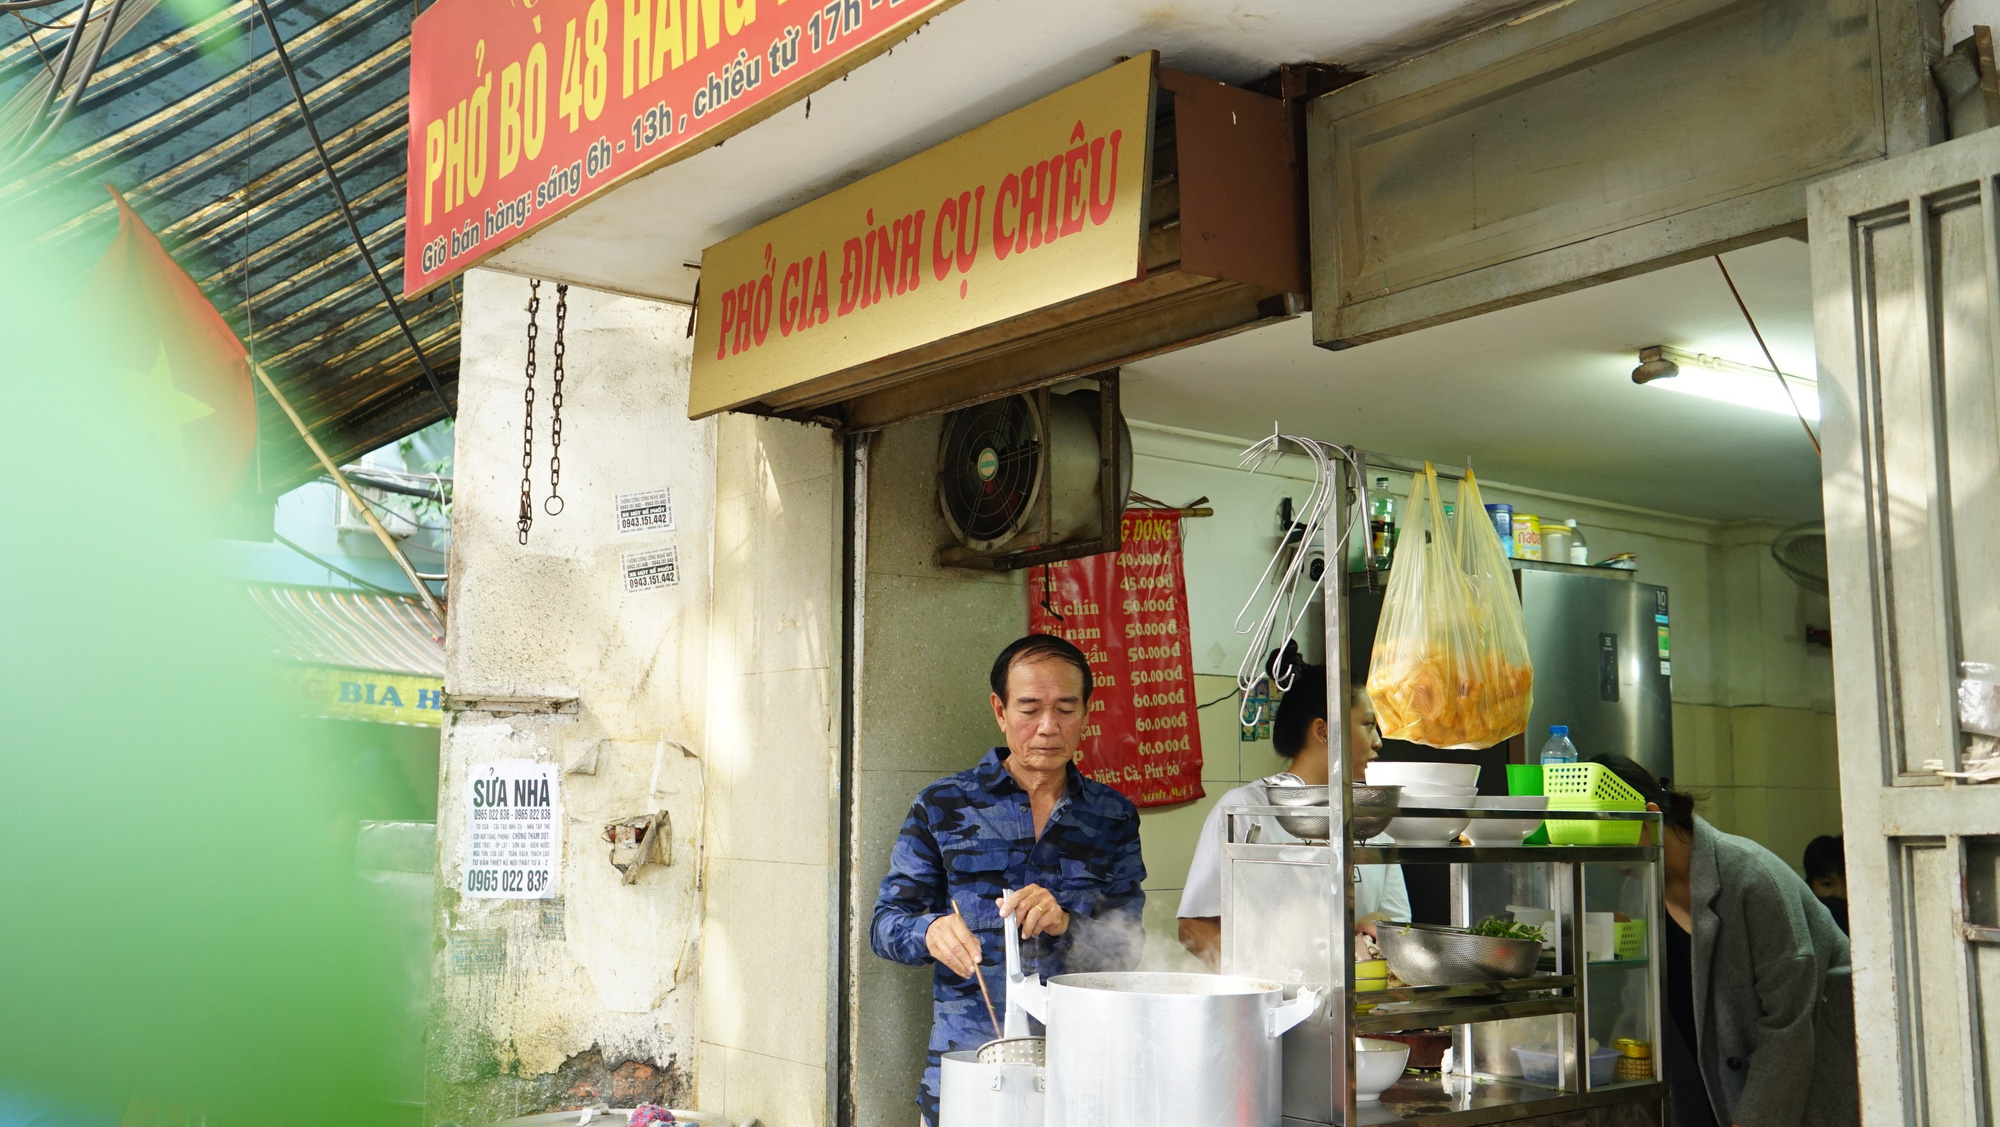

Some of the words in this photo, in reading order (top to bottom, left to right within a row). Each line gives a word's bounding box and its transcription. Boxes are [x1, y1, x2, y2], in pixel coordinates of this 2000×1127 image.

[424, 38, 492, 226] PHỞ
[499, 14, 547, 180] BÒ
[559, 0, 608, 133] 48
[422, 235, 447, 273] Giờ
[451, 219, 480, 259] bán
[484, 190, 532, 240] hàng:
[536, 159, 582, 208] sáng
[587, 135, 612, 178] 6h
[632, 100, 673, 151] 13h
[693, 48, 762, 119] chiều
[768, 26, 802, 77] từ
[808, 0, 862, 54] 17h
[717, 242, 778, 361] PHỞ
[779, 250, 830, 337] GIA
[837, 207, 926, 318] ĐÌNH
[932, 185, 986, 300] CỤ
[993, 119, 1123, 261] CHIÊU
[621, 513, 667, 529] 0943.151.442
[1133, 509, 1172, 541] ĐỒNG
[1116, 551, 1171, 567] 40.000đ
[629, 572, 675, 589] 0943.151.442
[1120, 572, 1174, 591] 45.000đ
[1064, 599, 1100, 616] chín
[1122, 596, 1175, 616] 50.000đ
[1656, 590, 1667, 607] 10
[1066, 627, 1101, 644] nạm
[1125, 619, 1179, 639] 50.000đ
[1127, 641, 1181, 662] 50.000đ
[1092, 671, 1116, 688] iòn
[1130, 664, 1183, 686] 50.000đ
[337, 681, 404, 708] BIA
[416, 688, 441, 710] H
[1133, 687, 1186, 708] 60.000đ
[1135, 711, 1188, 732] 60.000đ
[1138, 734, 1190, 756] 60.000đ
[1123, 764, 1142, 782] Cà,
[1166, 759, 1180, 776] bò
[473, 766, 508, 808] SỬA
[514, 772, 550, 808] NHÀ
[474, 809, 487, 820] 0965
[489, 809, 499, 820] 022
[500, 809, 510, 820] 836
[514, 809, 528, 820] 0965
[529, 809, 540, 820] 022
[541, 809, 551, 820] 836
[468, 869, 498, 892] 0965
[502, 869, 523, 892] 022
